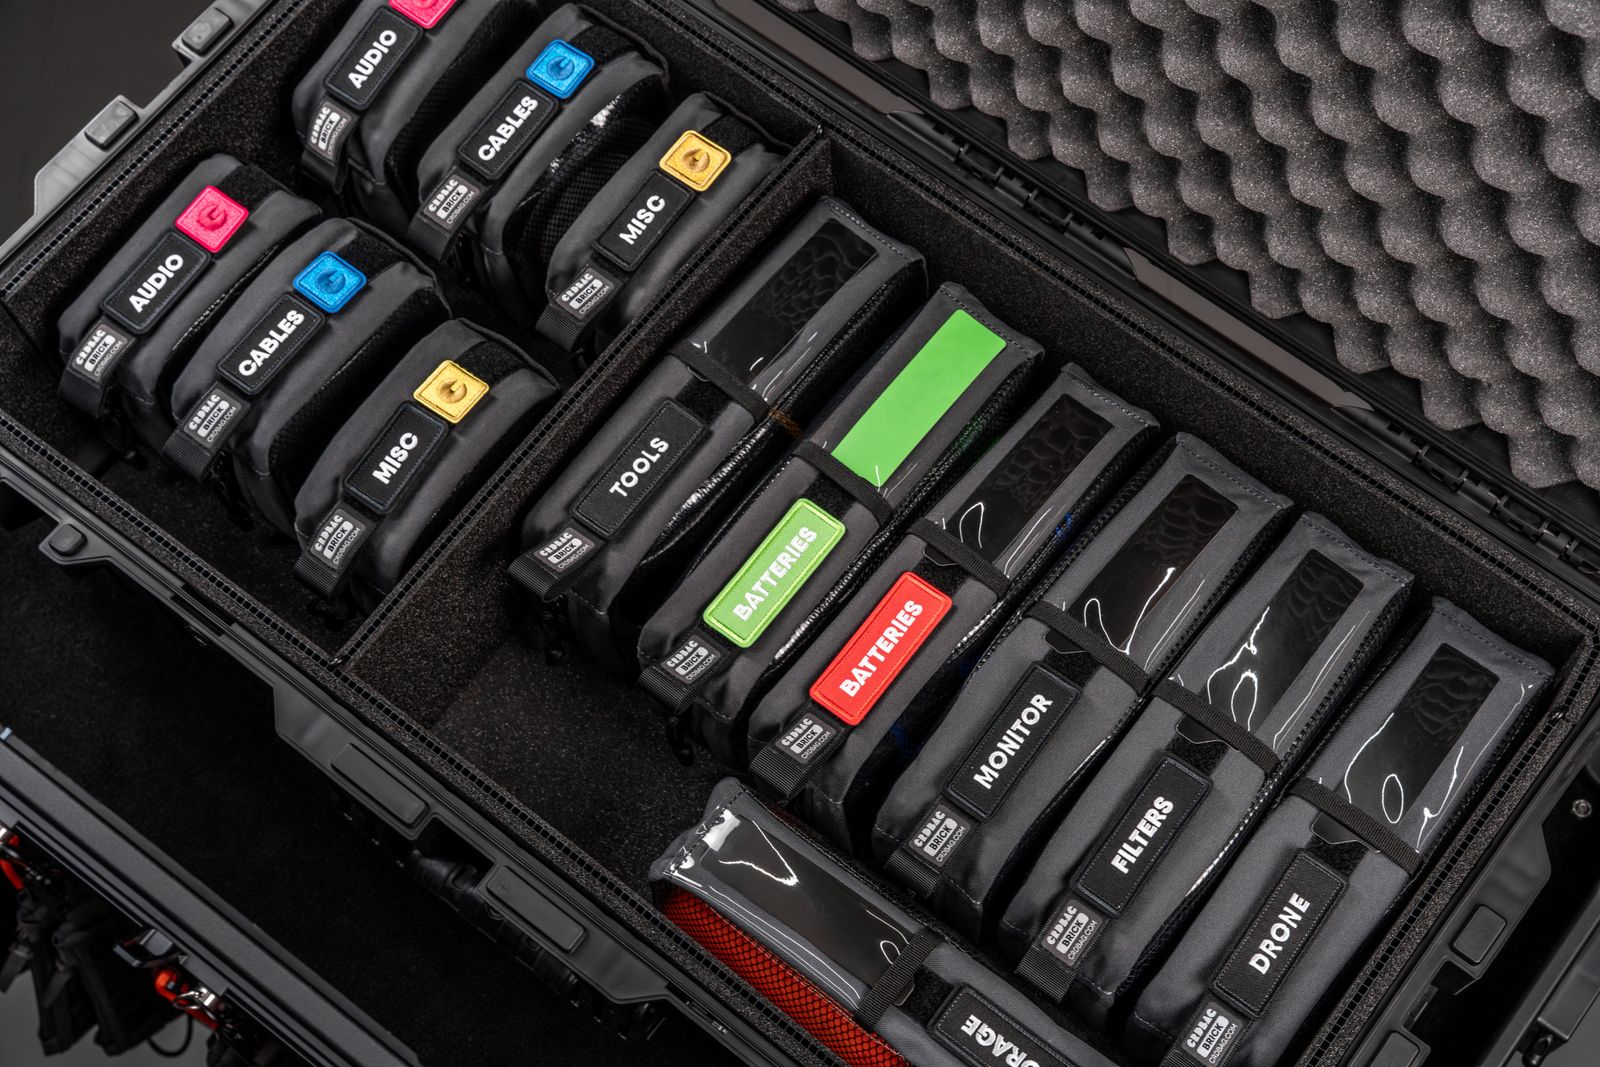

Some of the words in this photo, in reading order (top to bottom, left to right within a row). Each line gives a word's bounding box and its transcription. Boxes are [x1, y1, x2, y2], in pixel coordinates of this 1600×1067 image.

[348, 30, 397, 89] AUDIO
[321, 118, 336, 144] BRICK
[478, 96, 538, 161] CABLES
[442, 190, 463, 214] BRICK
[619, 195, 666, 245] MISC
[129, 254, 184, 313] AUDIO
[575, 283, 598, 304] BRICK
[89, 341, 110, 366] BRICK
[238, 309, 305, 376] CABLES
[188, 394, 221, 430] CRDBAG
[202, 406, 225, 432] BRICK
[372, 432, 419, 485] MISC
[609, 437, 669, 497] TOOLS
[327, 527, 348, 553] BRICK
[554, 542, 577, 561] BRICK
[732, 527, 818, 621] BATTERIES
[682, 651, 704, 672] BRICK
[839, 600, 923, 697] BATTERIES
[795, 729, 819, 749] BRICK
[973, 694, 1053, 789] MONITOR
[913, 811, 946, 847] CRDBAG
[929, 824, 953, 851] BRICK
[936, 826, 966, 862] CRDBAG.COM
[1110, 796, 1174, 874] FILTERS
[1046, 905, 1077, 945] CRDBAG
[1061, 919, 1084, 948] BRICK
[1067, 920, 1098, 960] CRDBAG.COM
[1248, 893, 1311, 975] DRONE
[1186, 1008, 1217, 1048] CRDBAG
[1202, 1022, 1224, 1051] BRICK
[1208, 1023, 1239, 1064] CRDBAG.COM
